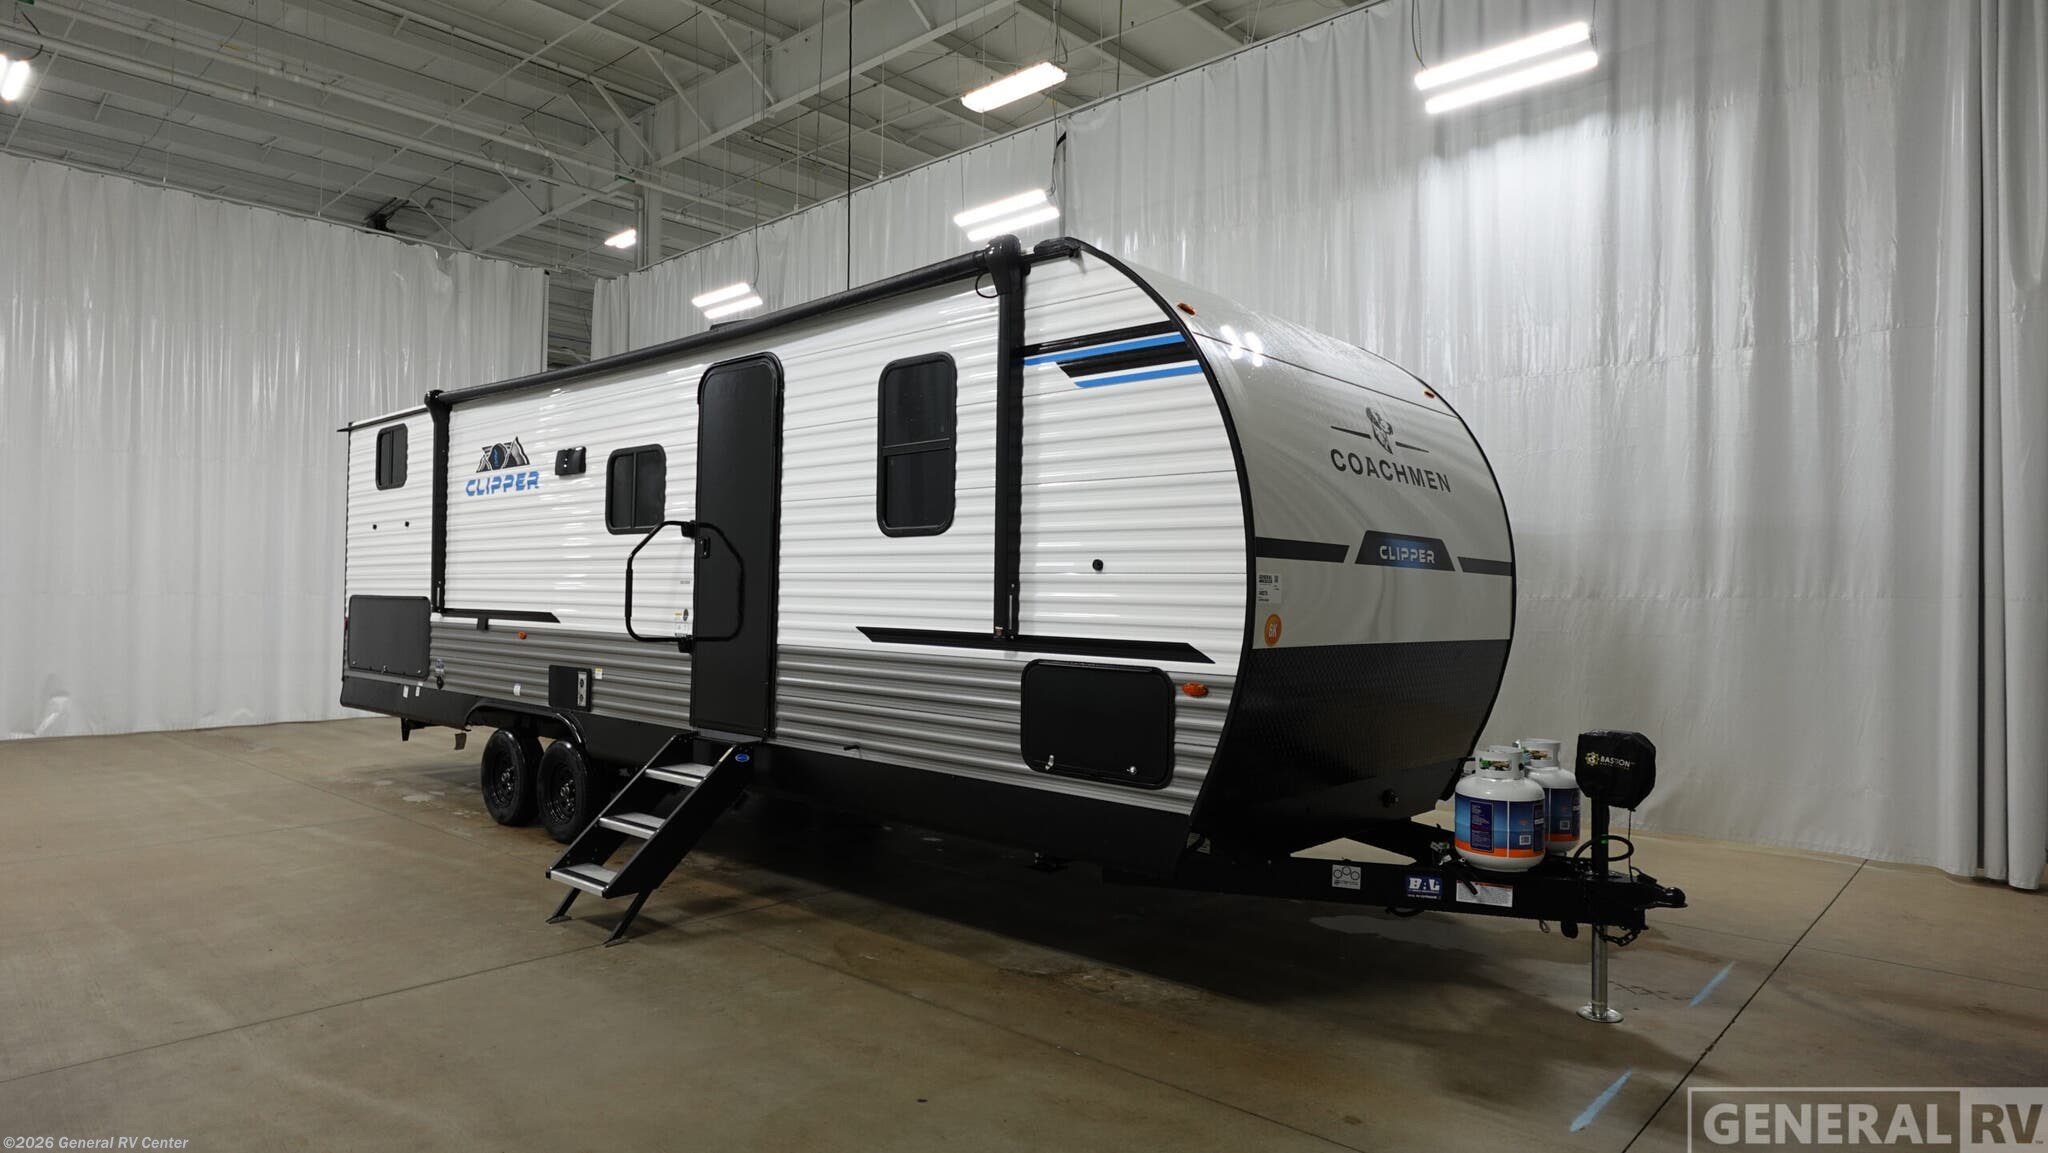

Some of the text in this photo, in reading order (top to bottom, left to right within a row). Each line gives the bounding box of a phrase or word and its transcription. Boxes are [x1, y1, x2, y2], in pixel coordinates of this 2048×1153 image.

[1330, 448, 1452, 493] COACHMEN
[465, 471, 539, 497] CLIPPER
[1378, 545, 1436, 564] CLIPPER
